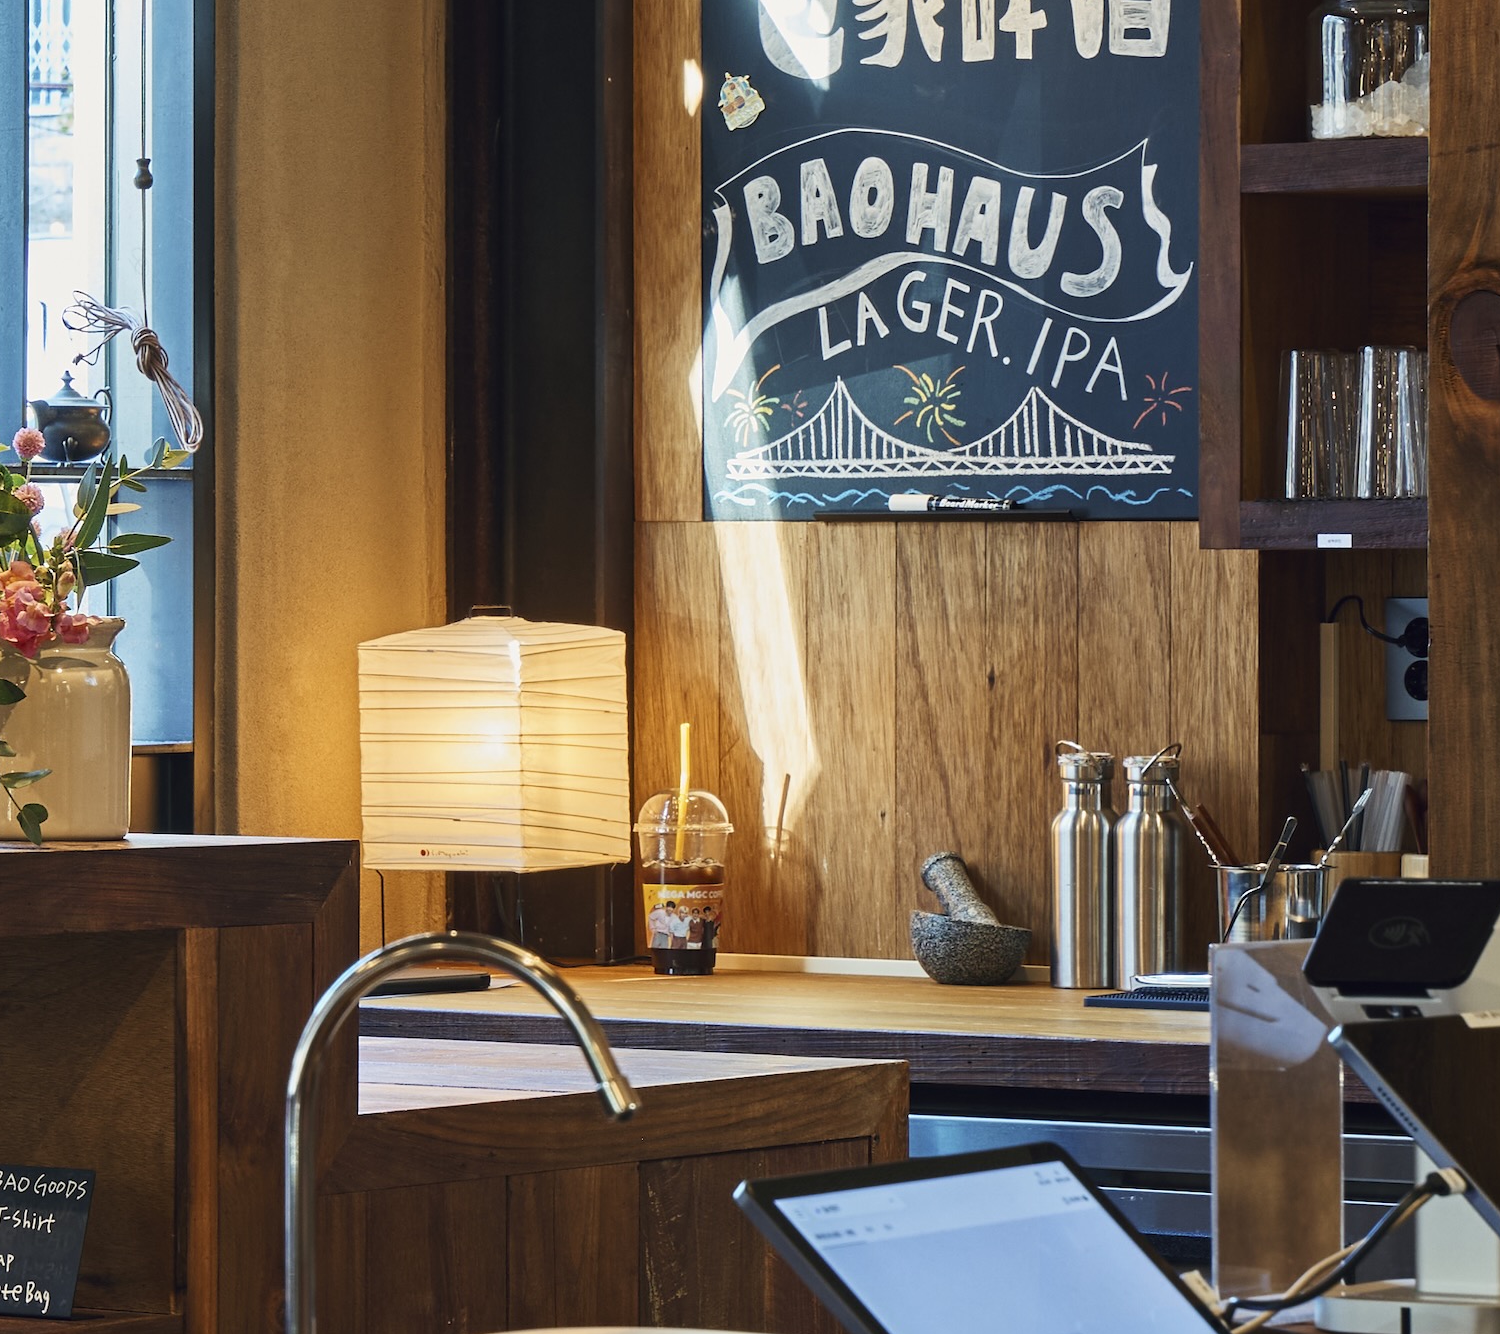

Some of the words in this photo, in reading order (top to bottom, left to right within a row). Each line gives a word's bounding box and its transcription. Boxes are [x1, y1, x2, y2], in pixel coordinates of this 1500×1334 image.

[742, 156, 1125, 298] BAOHAUS
[1025, 316, 1128, 401] IPA
[25, 1281, 50, 1315] Bag
